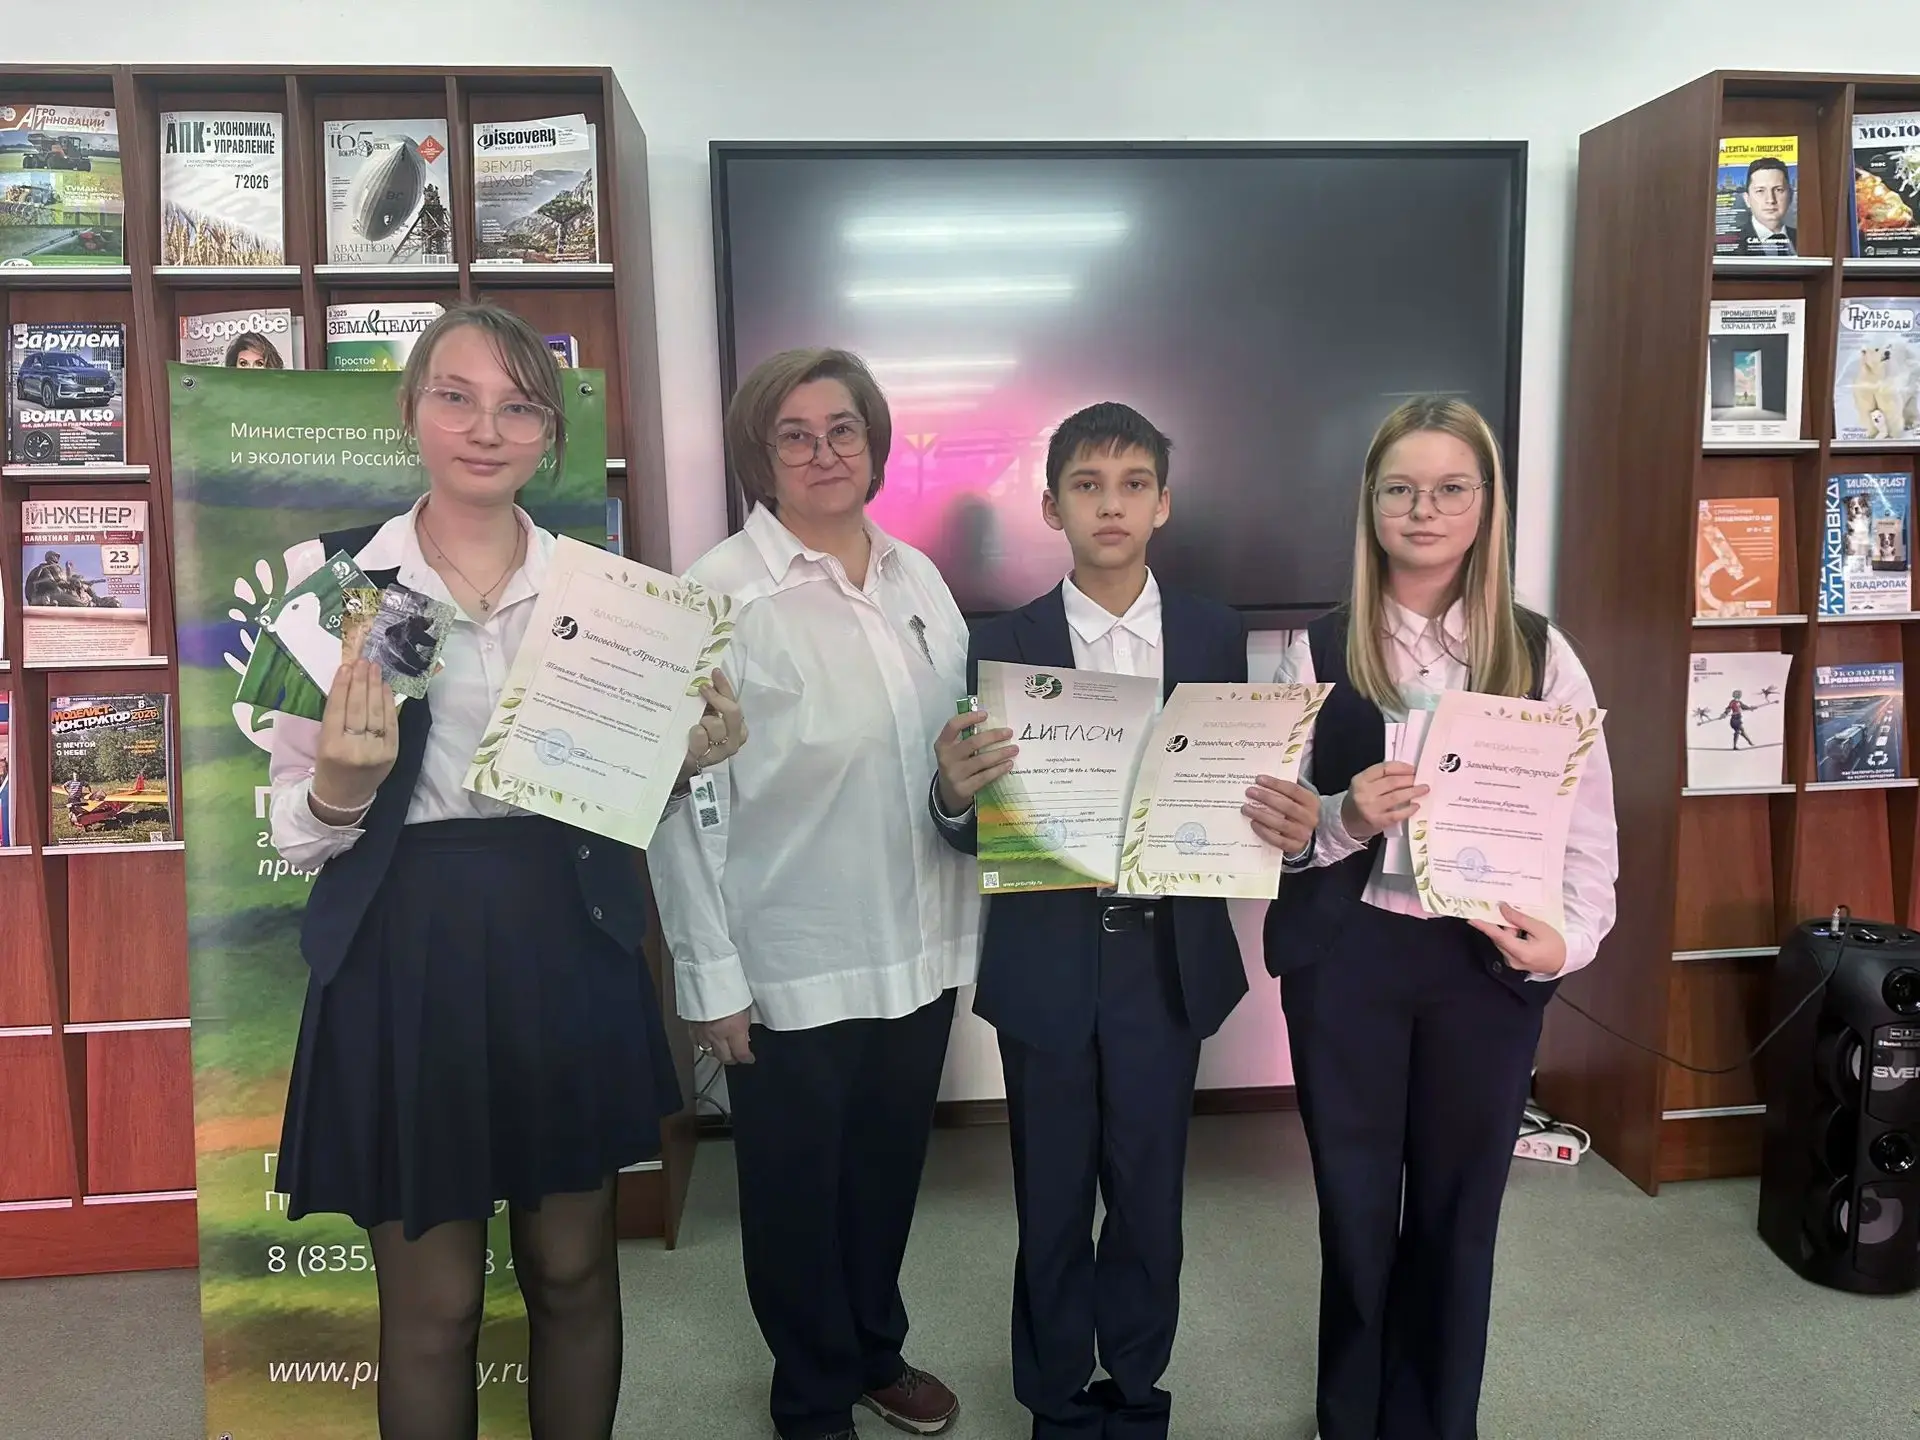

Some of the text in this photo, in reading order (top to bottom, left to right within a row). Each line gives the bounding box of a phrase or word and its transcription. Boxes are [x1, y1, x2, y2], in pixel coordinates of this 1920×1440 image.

[213, 121, 276, 138] ЭКОНОМИКА,
[1859, 125, 1920, 139] МОЛО
[214, 139, 275, 154] УПРАВЛЕНИЕ
[482, 160, 533, 174] ЗЕМЛЯ
[482, 174, 534, 189] ДУХОВ
[334, 243, 399, 253] АВАНТЮРА
[334, 253, 362, 262] ВЕКА
[1721, 309, 1777, 317] ПРОМЫШЛЕННАЯ
[1853, 316, 1911, 330] ПРИРОДЫ
[335, 356, 376, 367] Простое
[20, 410, 76, 422] ВОЛГА
[231, 423, 367, 443] Министерство
[231, 450, 425, 467] и экологии Российск
[1880, 477, 1907, 487] PLAST
[31, 506, 132, 525] ИНЖЕНЕР
[24, 534, 96, 542] ПАМЯТНАЯ ДАТА
[1826, 483, 1843, 600] УПАКОВКА
[109, 551, 130, 563] 23
[1850, 580, 1908, 590] КВАДРОПАК
[581, 629, 634, 656] Заповедник
[632, 649, 690, 675] «Присурский»
[1819, 674, 1895, 685] ПРОИЗВОДСТВА
[1832, 669, 1895, 678] ЭКОЛОГИЯ
[138, 700, 146, 709] 8
[56, 711, 130, 732] КОНСТРУКТОР
[1019, 722, 1124, 742] ДИПЛОМ
[64, 741, 96, 749] МЕЧТОЙ
[267, 1246, 286, 1273] 8
